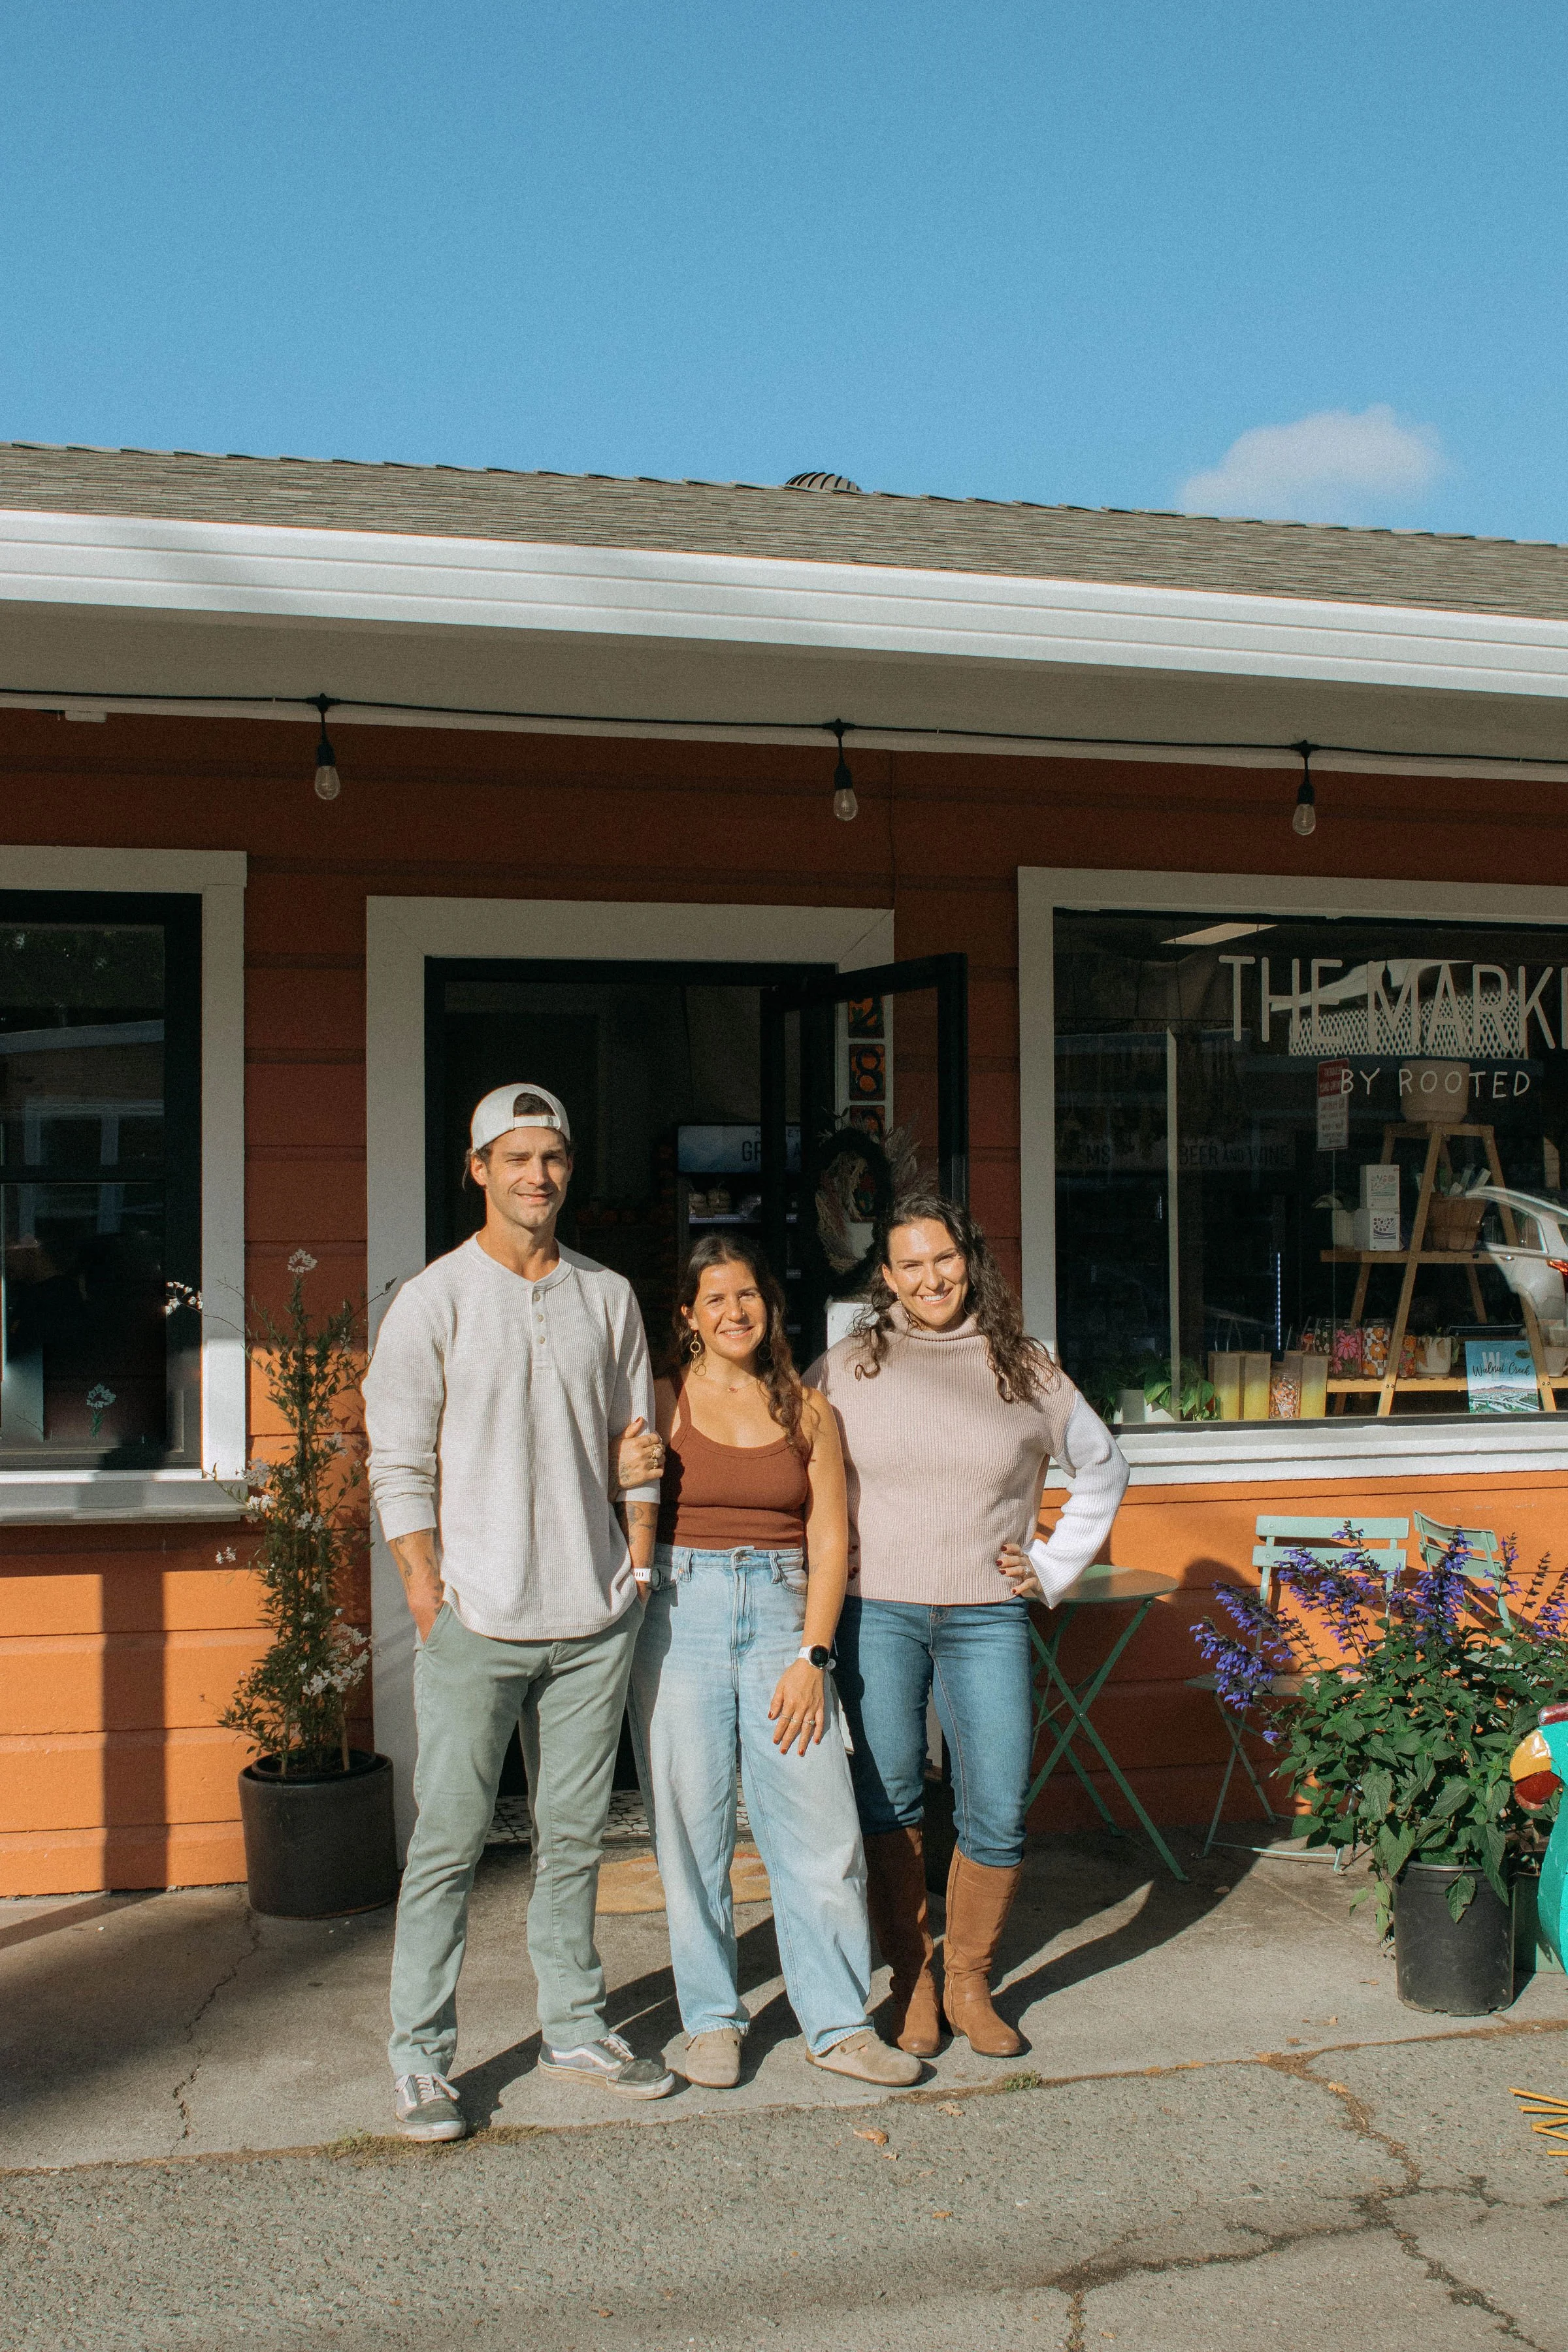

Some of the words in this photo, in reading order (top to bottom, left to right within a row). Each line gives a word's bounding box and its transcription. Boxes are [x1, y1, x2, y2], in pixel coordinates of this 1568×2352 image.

[1218, 955, 1343, 1043] THE
[1367, 959, 1568, 1050] MARK
[1341, 1068, 1380, 1095] BY
[1399, 1068, 1529, 1098] ROOTED
[1473, 1362, 1505, 1377] Walnut
[1509, 1361, 1531, 1376] Creek
